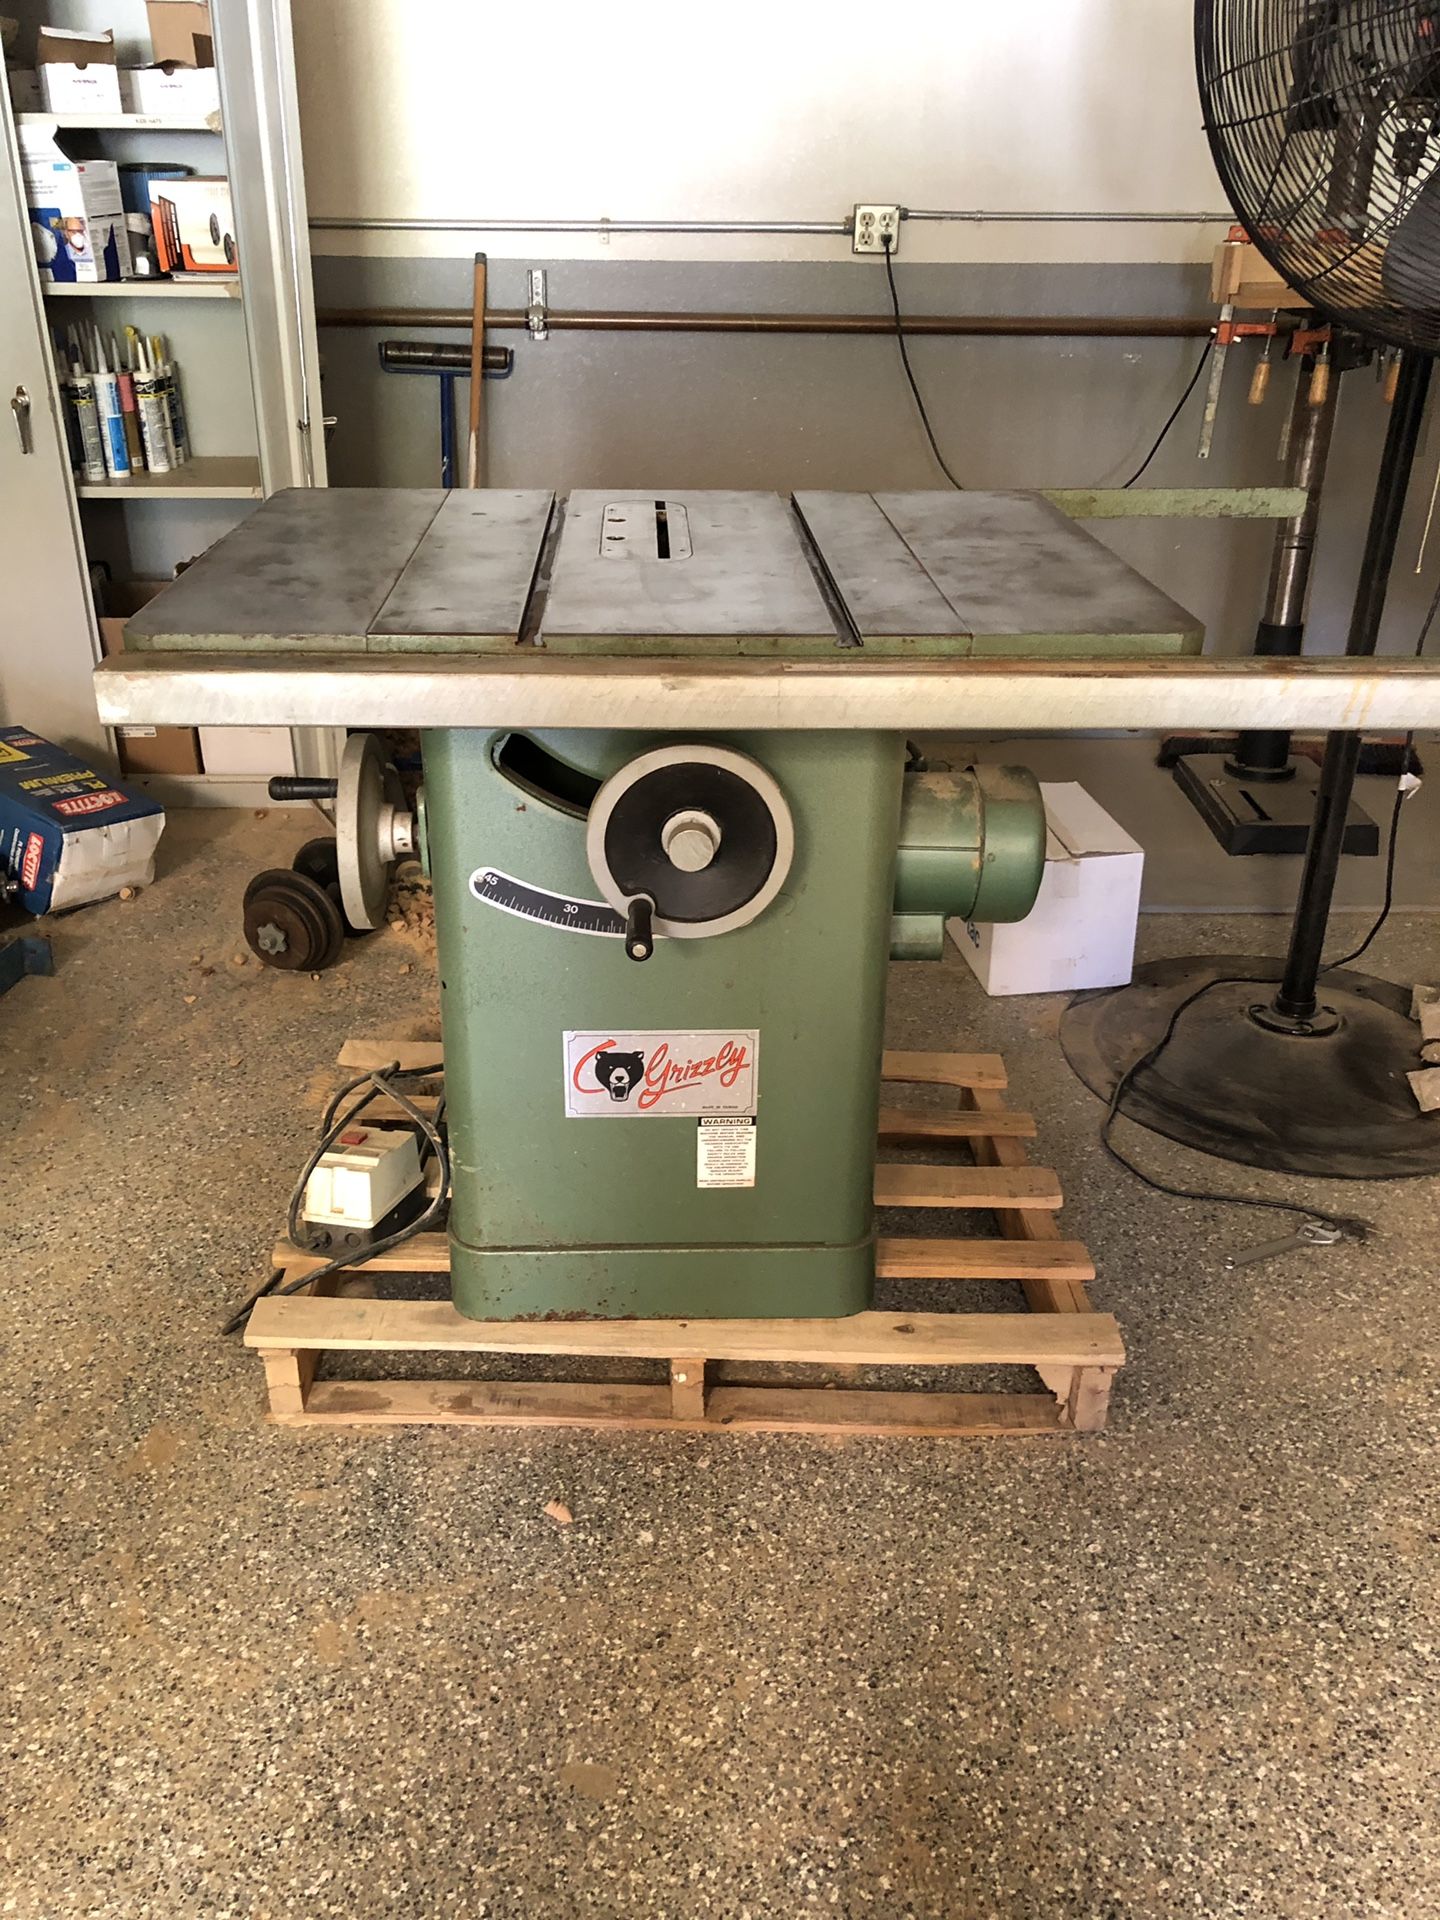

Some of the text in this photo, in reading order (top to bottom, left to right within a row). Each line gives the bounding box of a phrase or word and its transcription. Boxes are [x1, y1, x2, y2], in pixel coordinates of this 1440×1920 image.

[18, 769, 97, 790] PREMIUM
[61, 791, 122, 815] LOCTITE
[24, 834, 42, 888] LOCTITE
[485, 874, 499, 886] 45
[563, 903, 579, 914] 30
[637, 1040, 750, 1110] Grizzly
